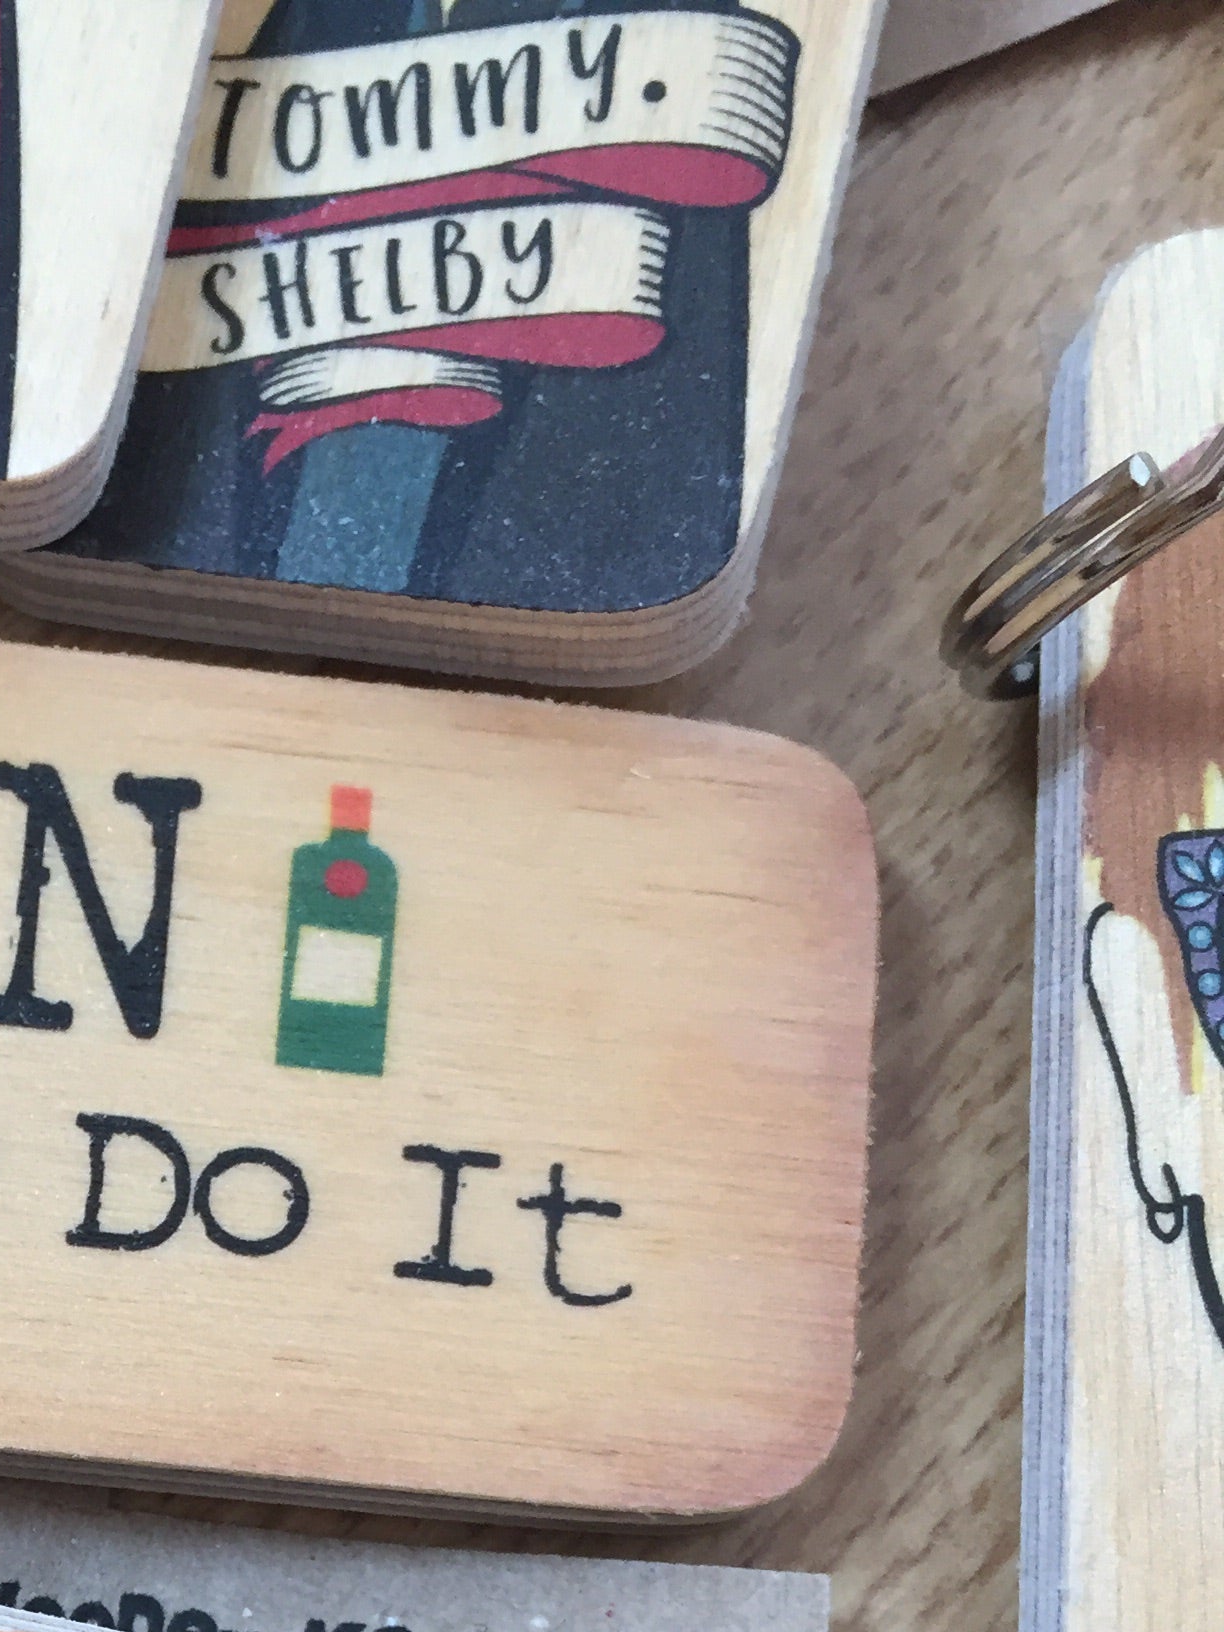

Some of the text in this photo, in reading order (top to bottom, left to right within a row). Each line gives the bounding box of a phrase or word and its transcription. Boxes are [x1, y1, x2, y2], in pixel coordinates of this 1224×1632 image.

[200, 216, 554, 356] SHELBY
[65, 1112, 311, 1257] Do
[393, 1144, 633, 1307] It
